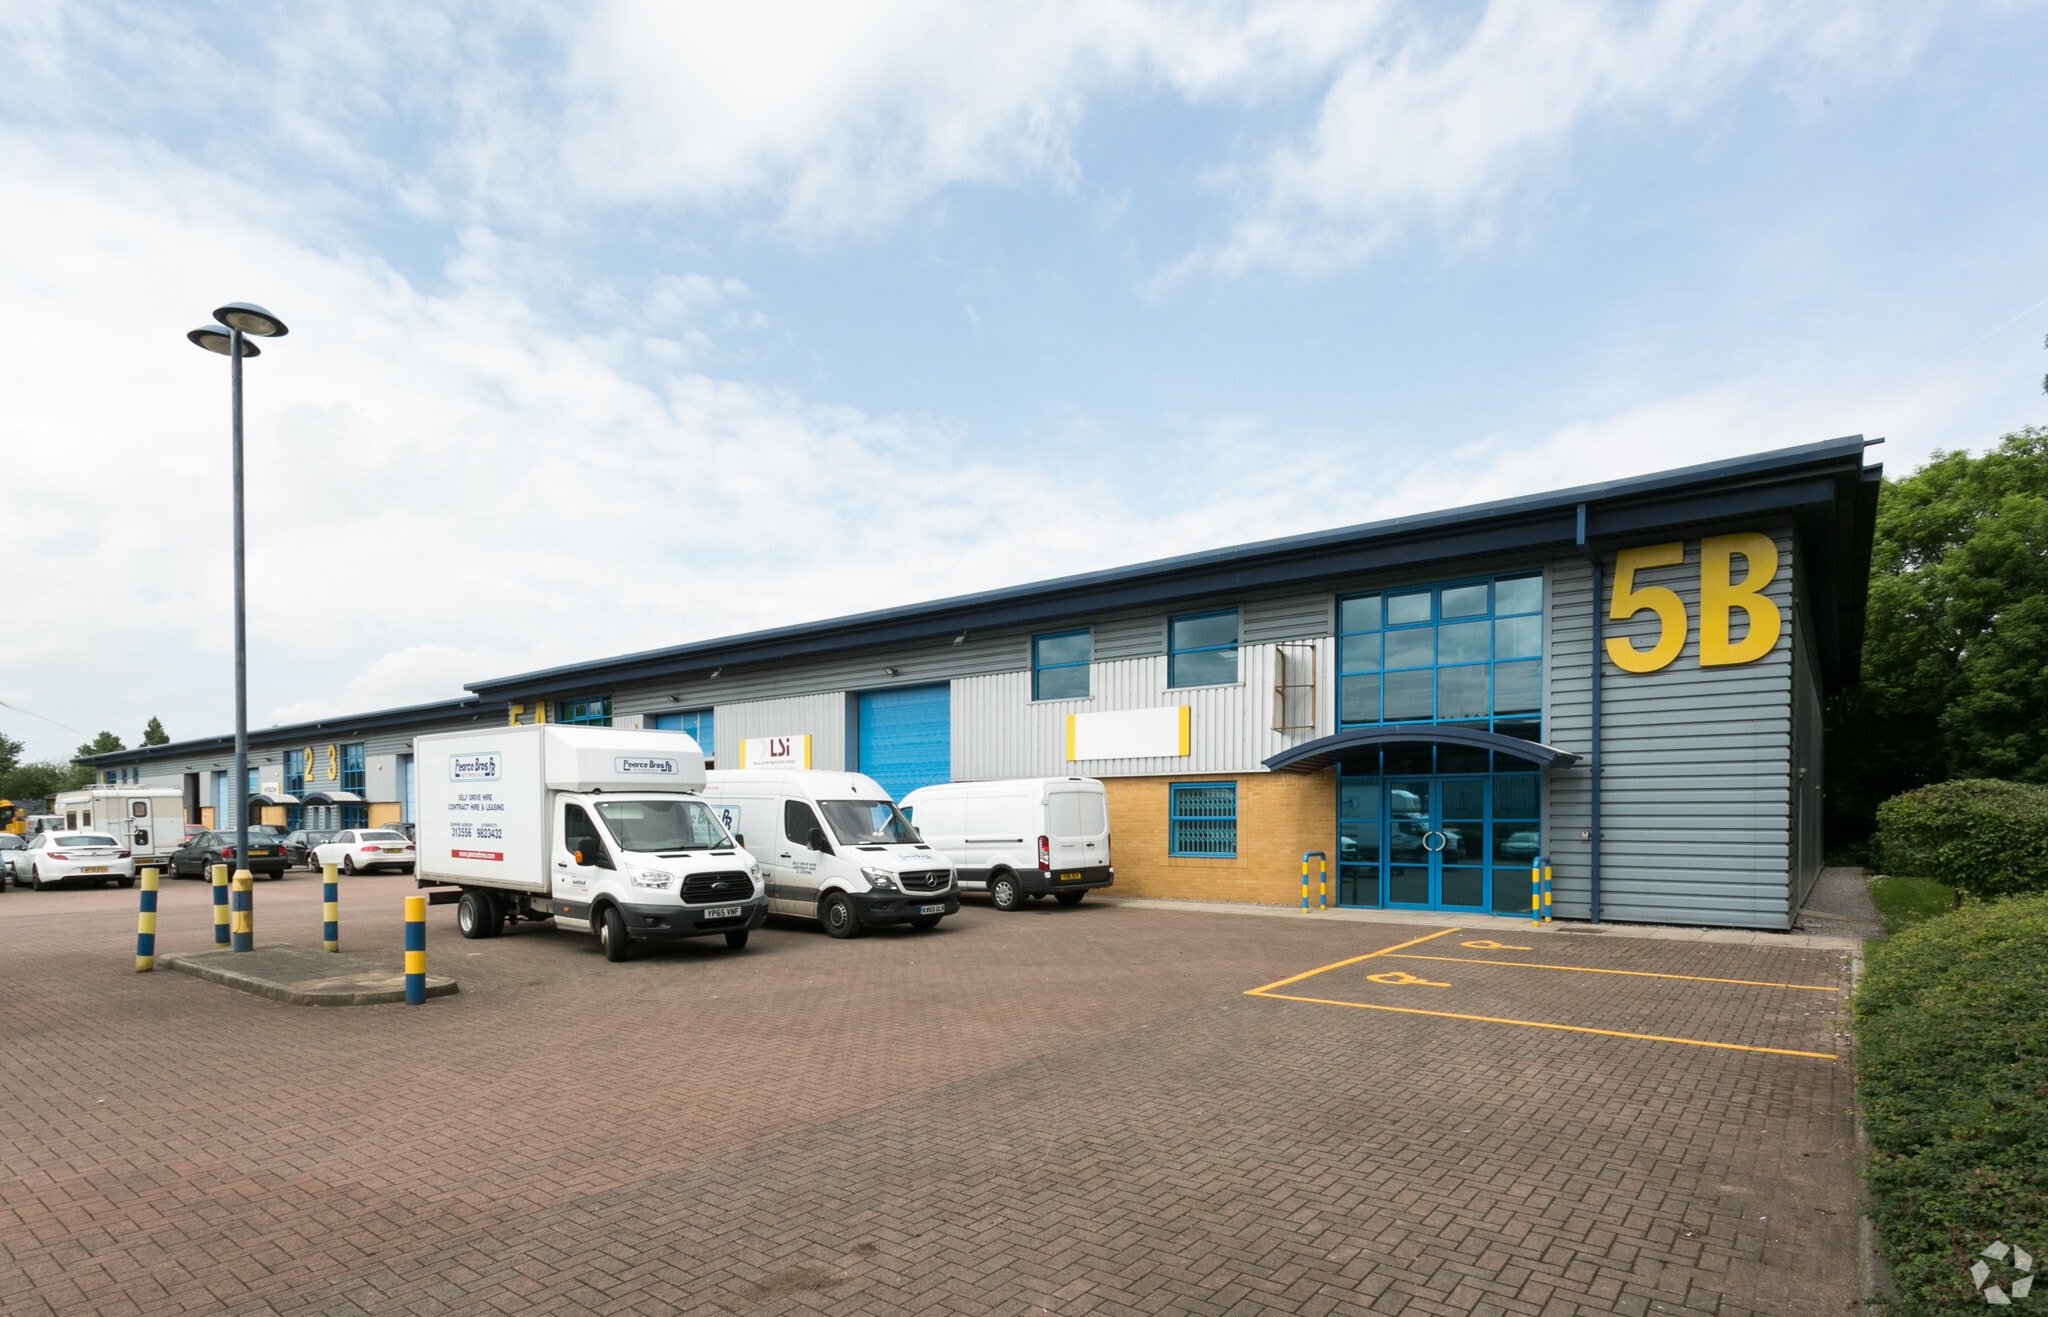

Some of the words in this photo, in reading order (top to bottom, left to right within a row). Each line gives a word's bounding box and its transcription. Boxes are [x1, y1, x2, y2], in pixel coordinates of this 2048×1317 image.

[1605, 532, 1781, 673] 5B
[304, 746, 314, 782] 2
[327, 743, 337, 780] 3
[455, 759, 474, 776] Pearce
[475, 757, 488, 771] Bros
[623, 759, 648, 771] Pearce
[649, 760, 665, 769] Bros
[486, 803, 504, 811] LEASING
